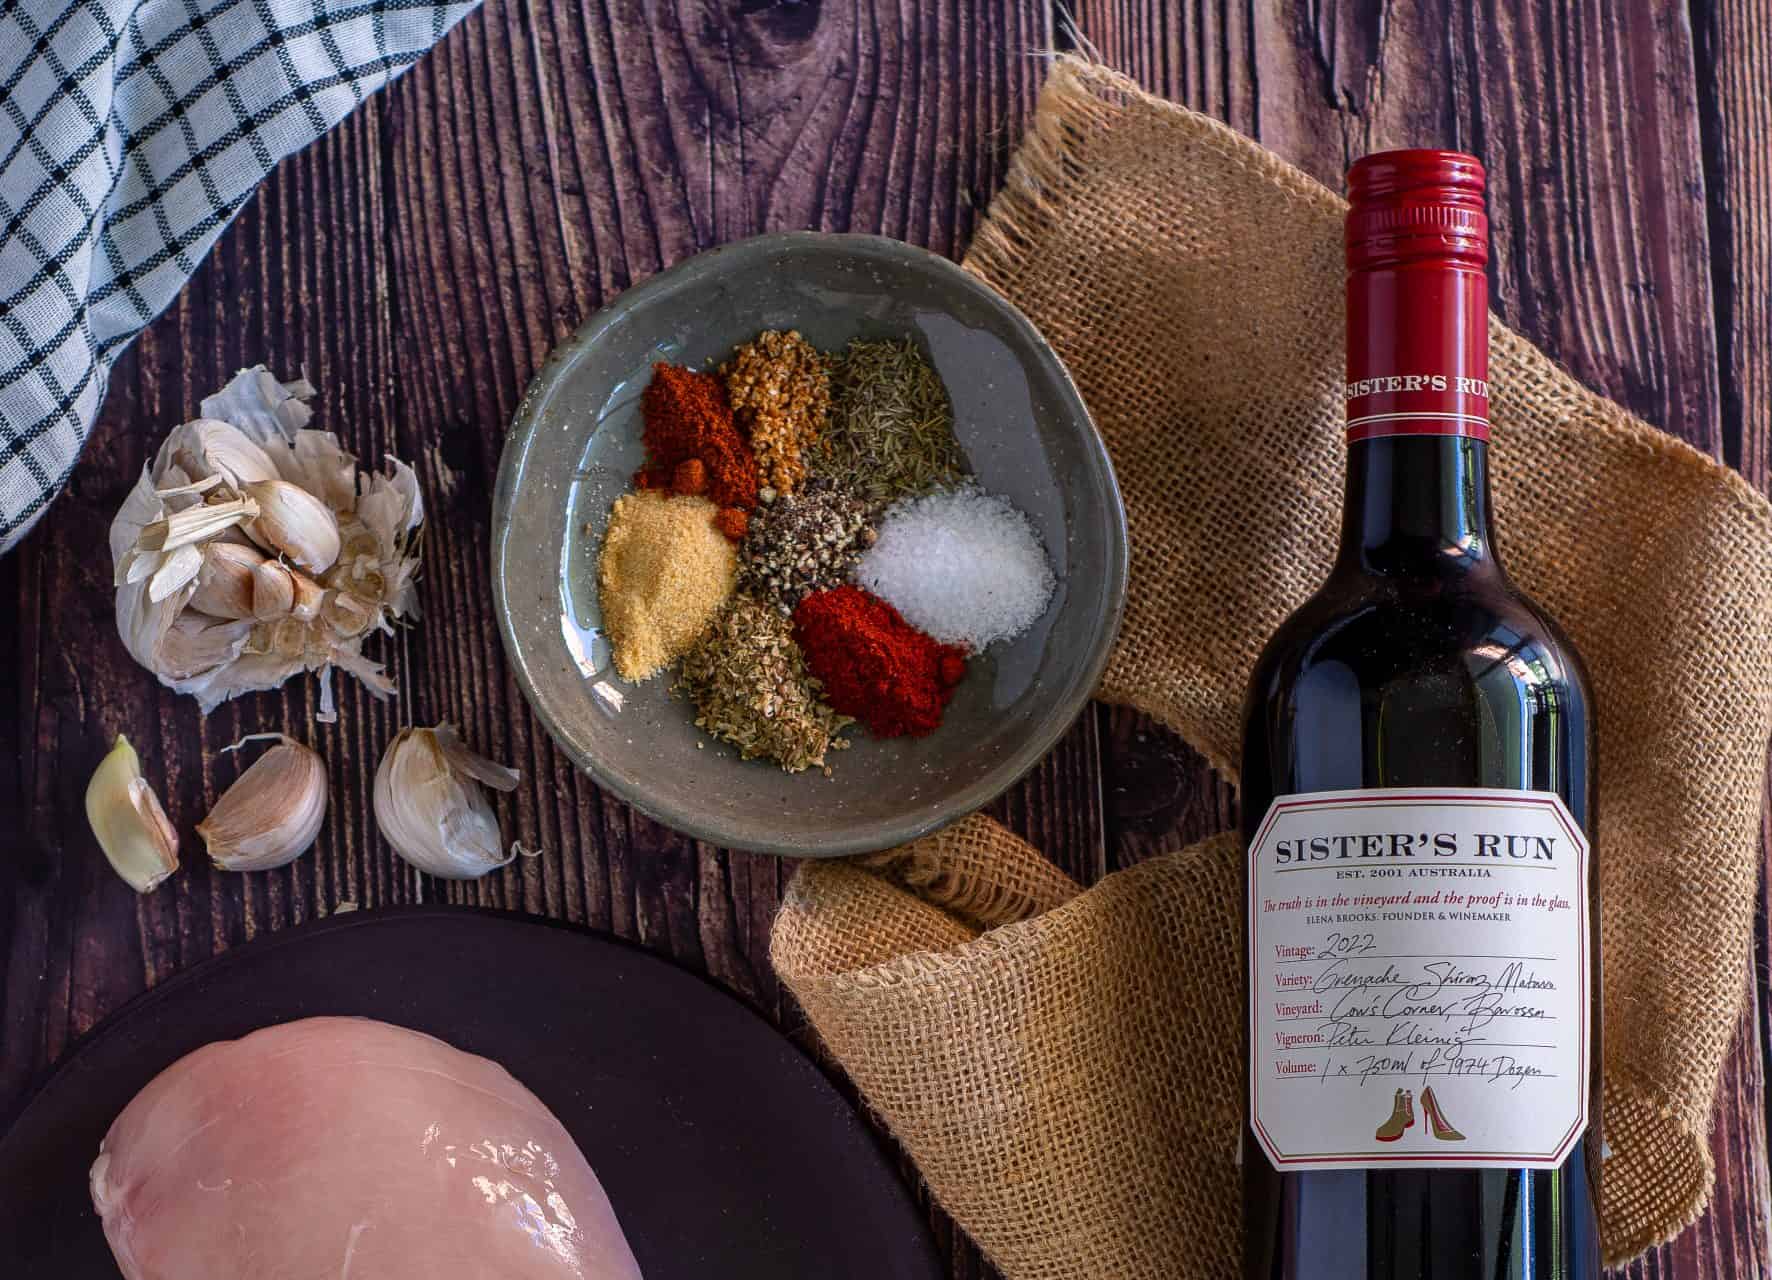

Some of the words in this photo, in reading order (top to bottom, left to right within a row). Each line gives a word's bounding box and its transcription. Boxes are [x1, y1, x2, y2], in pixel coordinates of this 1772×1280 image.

[1276, 833, 1457, 864] SISTER'S
[1474, 834, 1557, 861] RUN
[1336, 870, 1365, 880] EST.
[1370, 868, 1403, 878] 2001
[1408, 868, 1492, 879] AUSTRALIA
[1264, 898, 1276, 913] The
[1280, 896, 1302, 911] truth
[1305, 897, 1313, 909] is
[1316, 896, 1328, 908] in
[1331, 892, 1351, 907] the
[1354, 890, 1412, 908] vineyard
[1414, 891, 1441, 904] and
[1444, 891, 1464, 904] the
[1466, 891, 1503, 909] proof
[1504, 894, 1513, 905] is
[1517, 895, 1529, 907] in
[1532, 893, 1548, 907] the
[1306, 913, 1334, 924] ELENA
[1383, 911, 1435, 921] FOUNDER
[1438, 911, 1447, 921] &
[1449, 911, 1512, 922] WINEMAKER
[1275, 945, 1316, 959] Vintage:
[1318, 933, 1377, 959] 2022
[1275, 973, 1313, 988] Variety:
[1313, 958, 1411, 993] Grenache
[1275, 1000, 1323, 1017] Vineyard:
[1275, 1032, 1325, 1048] Vigneron:
[1275, 1061, 1317, 1074] Volume:
